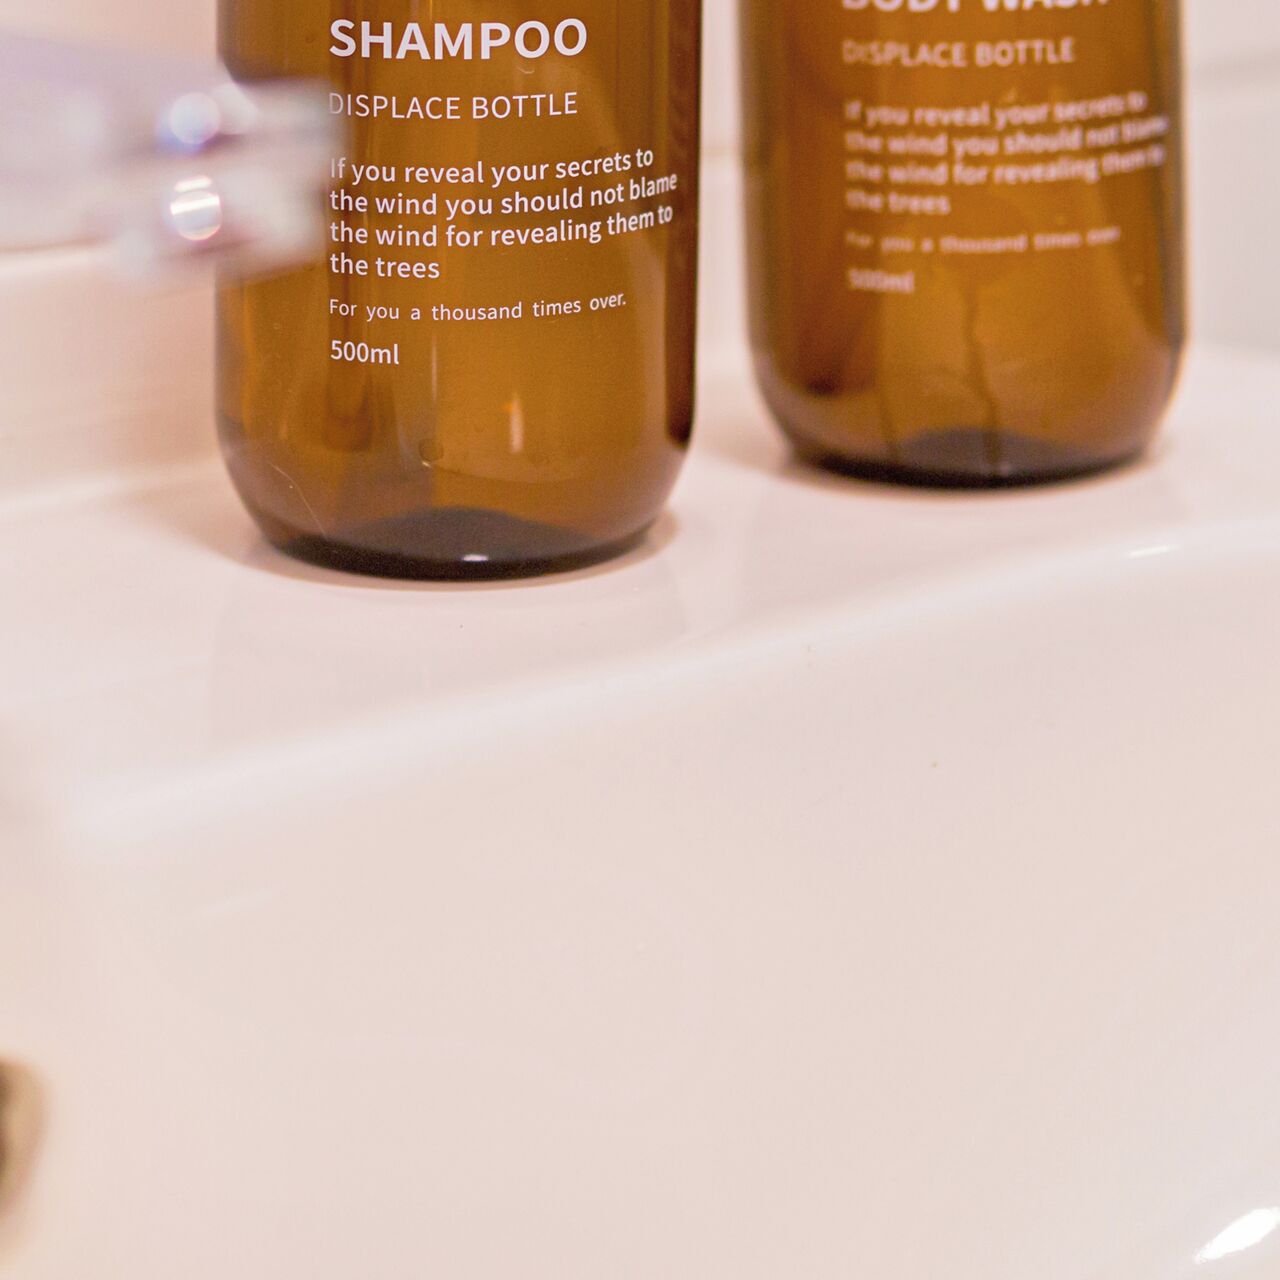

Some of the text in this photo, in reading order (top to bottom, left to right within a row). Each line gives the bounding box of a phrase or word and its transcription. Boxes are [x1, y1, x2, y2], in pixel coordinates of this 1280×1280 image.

[328, 17, 588, 61] SHAMPOO
[842, 37, 1076, 67] DISPLACE BOTTLE
[329, 91, 578, 120] DISPLACE BOTTLE
[330, 148, 654, 189] If you reveal your secrets to
[329, 173, 678, 222] the wind you should not blame
[329, 204, 673, 248] the wind for revealing them to
[329, 251, 441, 280] the trees
[329, 291, 627, 323] For you a thousand times over.
[330, 339, 400, 365] 500ml
